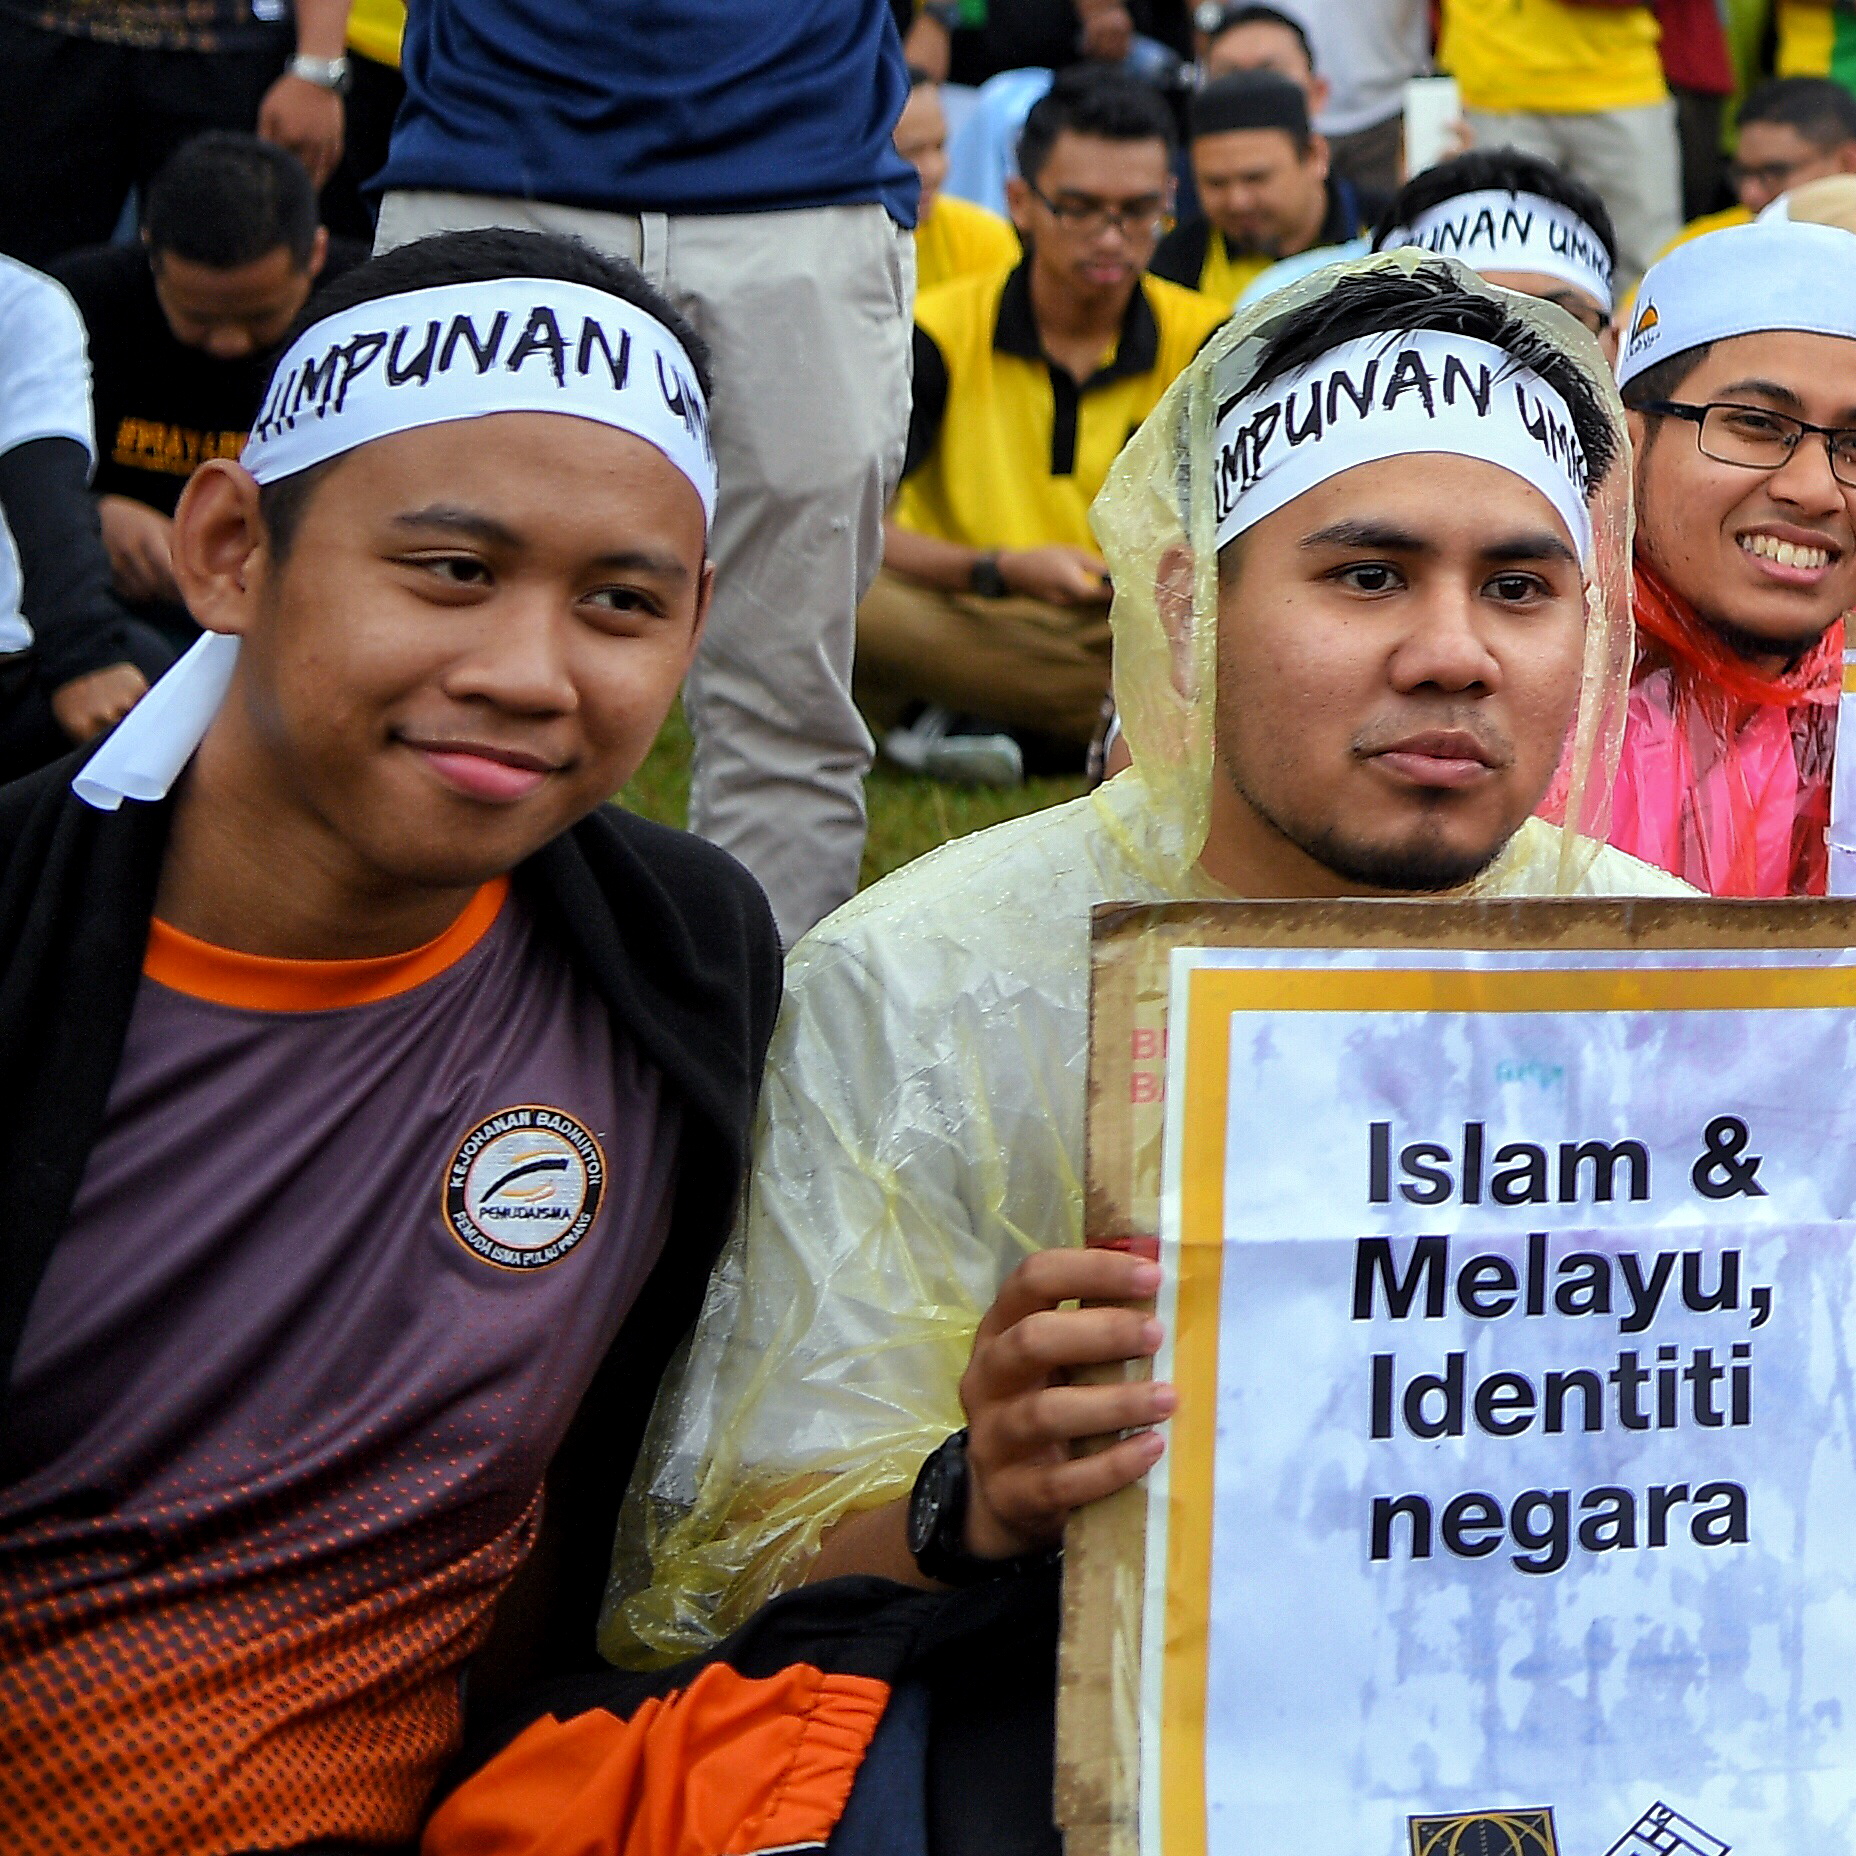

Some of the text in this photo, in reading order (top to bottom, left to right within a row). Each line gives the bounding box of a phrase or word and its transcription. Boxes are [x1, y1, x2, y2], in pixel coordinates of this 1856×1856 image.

[451, 1110, 602, 1188] KEJOHANAN BADMINTON
[1366, 1113, 1768, 1205] Islam &
[1352, 1233, 1774, 1333] Melayu,
[1369, 1342, 1753, 1441] Identiti
[1369, 1478, 1750, 1575] negara
